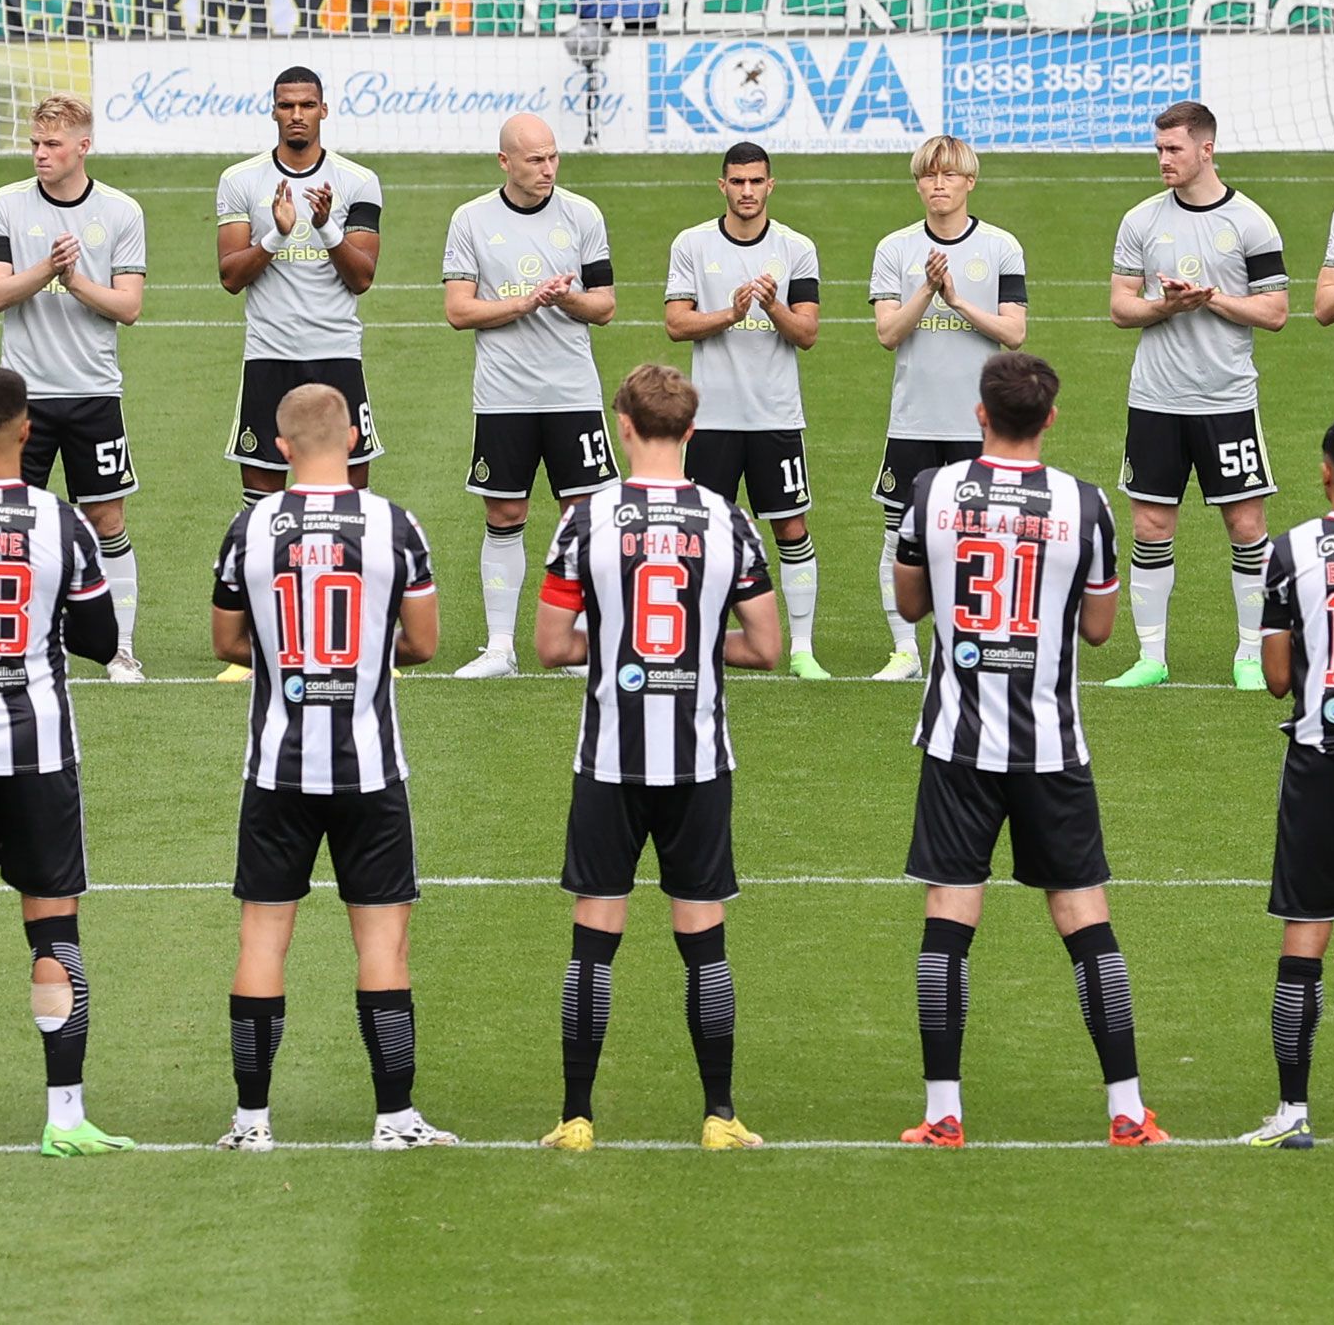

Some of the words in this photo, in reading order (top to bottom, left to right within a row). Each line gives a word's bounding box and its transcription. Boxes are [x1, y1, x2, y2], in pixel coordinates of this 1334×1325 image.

[648, 40, 925, 134] KOVA
[954, 63, 1034, 93] 0333
[1043, 63, 1103, 93] 355
[1111, 63, 1193, 93] 5225
[105, 66, 274, 123] Kitchens
[338, 70, 550, 118] Bathrooms
[272, 243, 330, 261] afabe
[497, 281, 538, 299] dafa
[917, 313, 977, 332] afabe
[358, 401, 371, 437] 6
[95, 435, 125, 476] 57
[579, 429, 607, 468] 13
[1218, 437, 1260, 478] 56
[780, 456, 805, 494] 11
[988, 493, 1027, 504] LEASING
[989, 484, 1013, 496] FIRST
[1013, 486, 1052, 500] VEHICLE
[303, 514, 327, 524] FIRST
[327, 515, 365, 525] VEHICLE
[648, 505, 672, 515] FIRST
[673, 506, 709, 519] VEHICLE
[648, 514, 685, 523] LEASING
[303, 522, 340, 531] LEASING
[936, 509, 1070, 543] GALLAGHER
[288, 543, 345, 568] MAIN
[621, 532, 702, 557] O'HARA
[952, 536, 1043, 637] 31
[271, 571, 364, 668] 10
[631, 561, 690, 658] 6
[982, 646, 1035, 660] consilium
[305, 679, 355, 692] consilium
[647, 669, 697, 680] consilium
